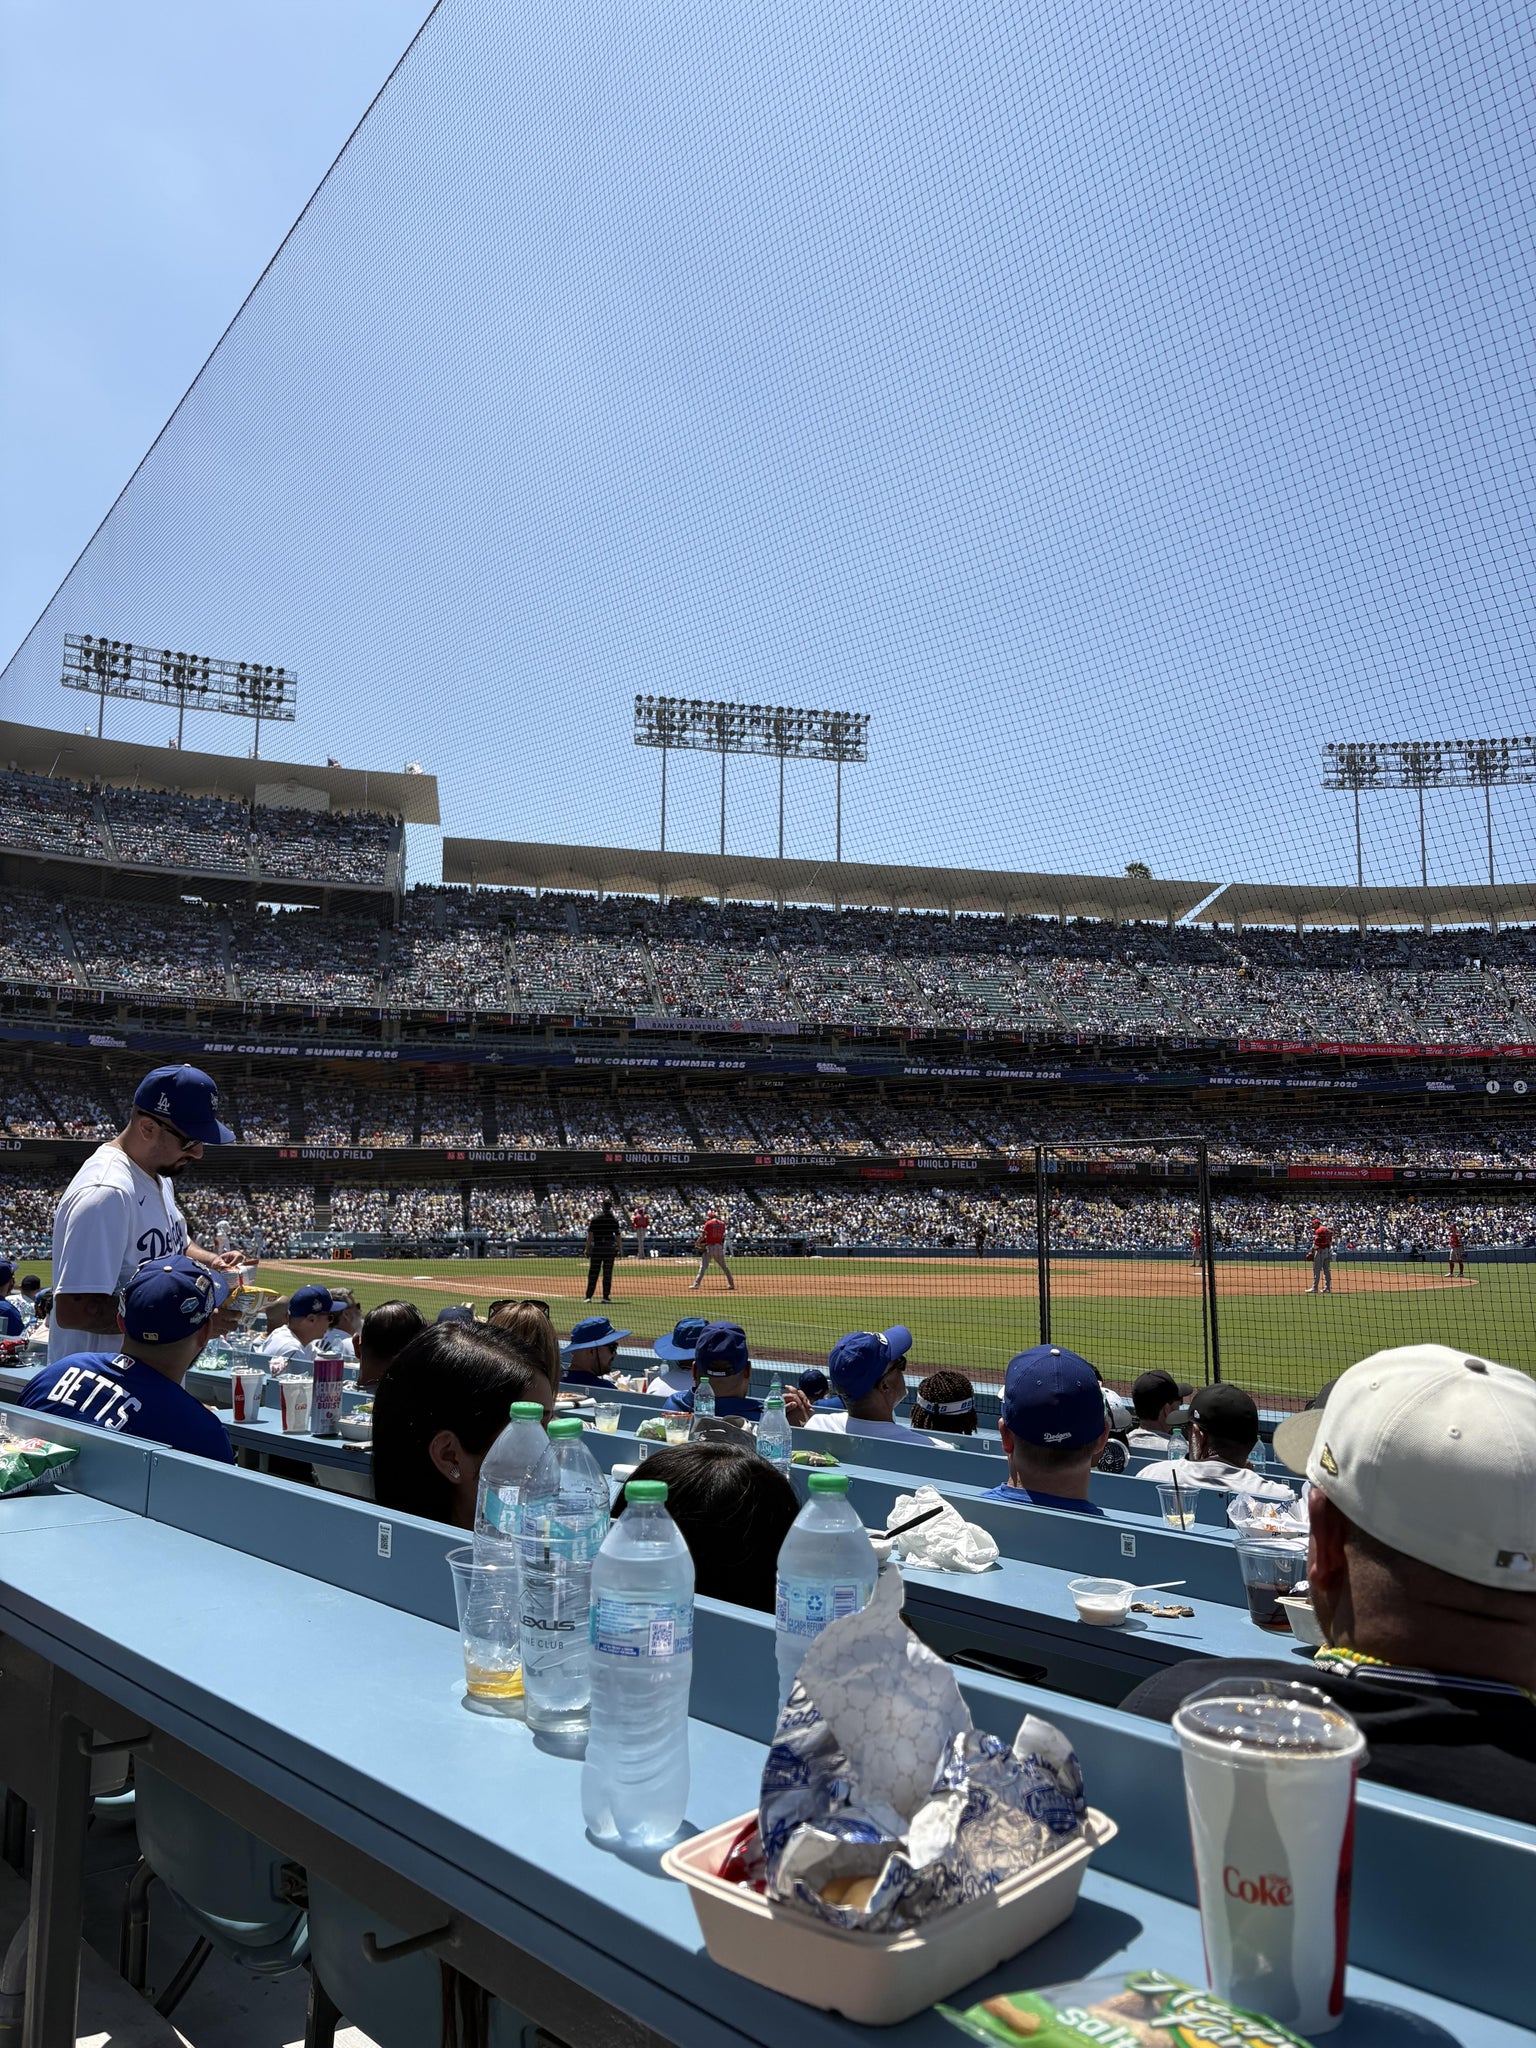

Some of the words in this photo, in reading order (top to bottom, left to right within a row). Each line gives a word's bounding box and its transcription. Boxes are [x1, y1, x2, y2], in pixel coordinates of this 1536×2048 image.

[3, 988, 21, 996] .416
[33, 990, 52, 999] .938
[203, 1043, 235, 1052] NEW
[238, 1045, 299, 1055] COASTER
[305, 1048, 363, 1057] SUMMER
[574, 1056, 602, 1064] NEW
[604, 1057, 659, 1066] COASTER
[664, 1059, 715, 1068] SUMMER
[903, 1067, 928, 1075] NEW
[931, 1068, 981, 1076] COASTER
[985, 1070, 1033, 1078] SUMMER
[1209, 1077, 1232, 1085] NEW
[1234, 1078, 1281, 1086] COASTER
[1286, 1079, 1331, 1087] SUMMER
[1490, 1083, 1496, 1091] 1
[1517, 1083, 1523, 1091] 2
[157, 1092, 171, 1111] LA
[0, 1140, 21, 1151] ELD
[301, 1149, 340, 1160] UNIQLO
[343, 1150, 374, 1160] FIELD
[468, 1151, 505, 1162] UNIQLO
[508, 1152, 537, 1161] FIELD
[625, 1153, 660, 1164] UNIQLO
[662, 1154, 690, 1163] FIELD
[774, 1156, 807, 1167] UNIQLO
[810, 1157, 836, 1166] FIELD
[917, 1159, 949, 1169] UNIQLO
[951, 1160, 978, 1169] FIELD
[47, 1366, 142, 1432] BETTS
[1043, 1432, 1072, 1443] Dodgers
[537, 1639, 564, 1650] CLUB
[1223, 1865, 1294, 1907] Coke
